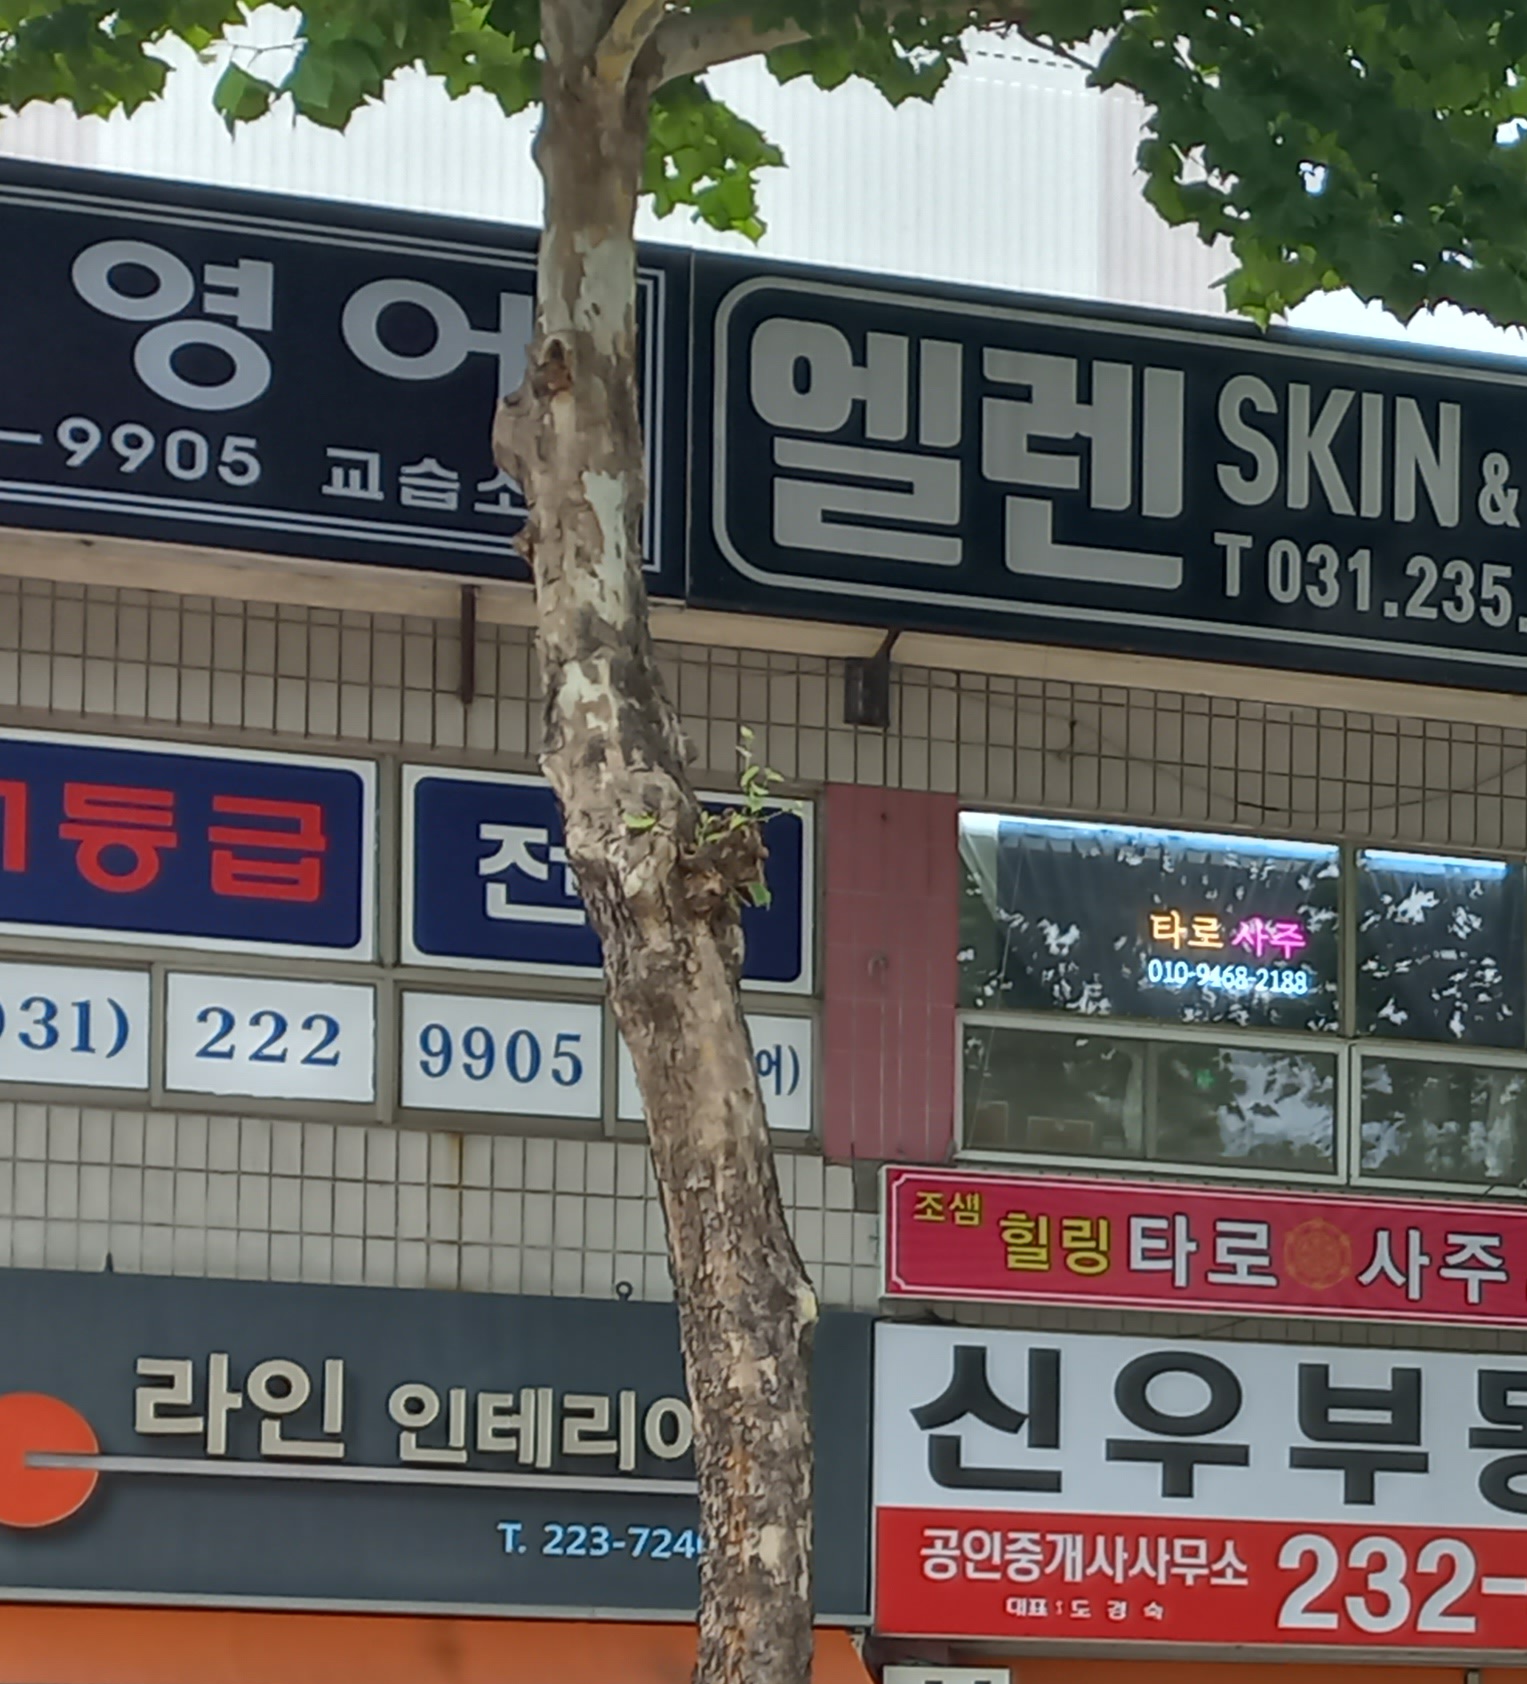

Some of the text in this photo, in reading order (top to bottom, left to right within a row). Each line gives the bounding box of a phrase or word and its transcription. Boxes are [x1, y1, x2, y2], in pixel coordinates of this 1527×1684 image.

[322, 447, 531, 514] 교습소
[750, 317, 1184, 590] 엘렌
[1216, 374, 1460, 528] SKIN
[1477, 452, 1519, 527] &
[1214, 531, 1253, 598] T
[1150, 909, 1306, 960] 타로 사주
[1148, 958, 1308, 995] 010-9468-2188
[0, 997, 129, 1057] 31)
[195, 1007, 342, 1068] 222
[418, 1023, 584, 1087] 9905
[1000, 1213, 1511, 1306] 힐링 타로 사주
[134, 1352, 345, 1461] 라인
[497, 1521, 698, 1560] T. 223-724
[920, 1526, 1249, 1587] 공인중개사사무소
